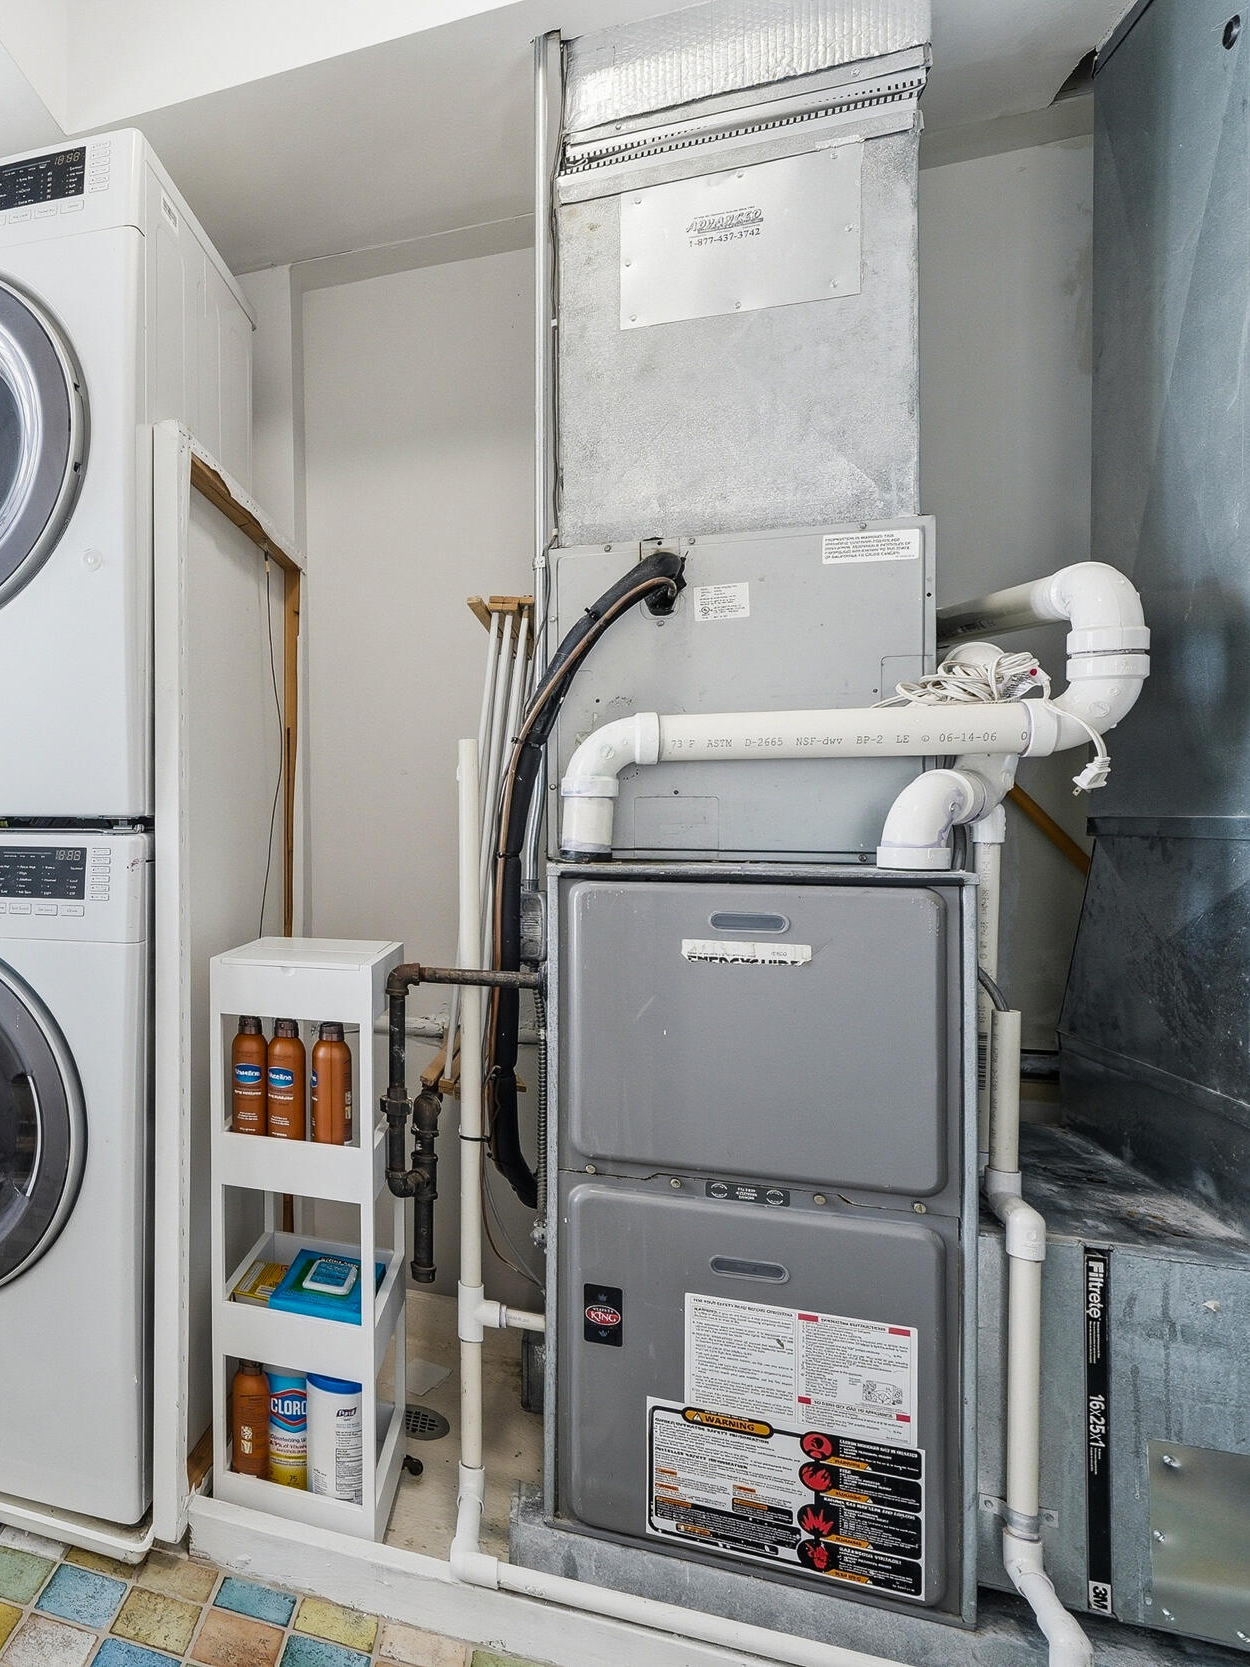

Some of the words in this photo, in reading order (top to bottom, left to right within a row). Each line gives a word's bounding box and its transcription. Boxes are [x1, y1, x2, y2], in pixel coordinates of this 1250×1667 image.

[689, 227, 761, 248] 1-877-437-3742
[706, 738, 733, 748] ASTM
[744, 737, 784, 747] D-2665
[795, 736, 843, 746] NSF-dwv
[938, 732, 997, 742] 06-14-06
[1086, 1260, 1105, 1320] Filtrete
[590, 1310, 617, 1323] KING
[704, 1415, 756, 1432] WARNING
[1089, 1393, 1106, 1449] 16x25x1
[1091, 1584, 1109, 1612] 3M
